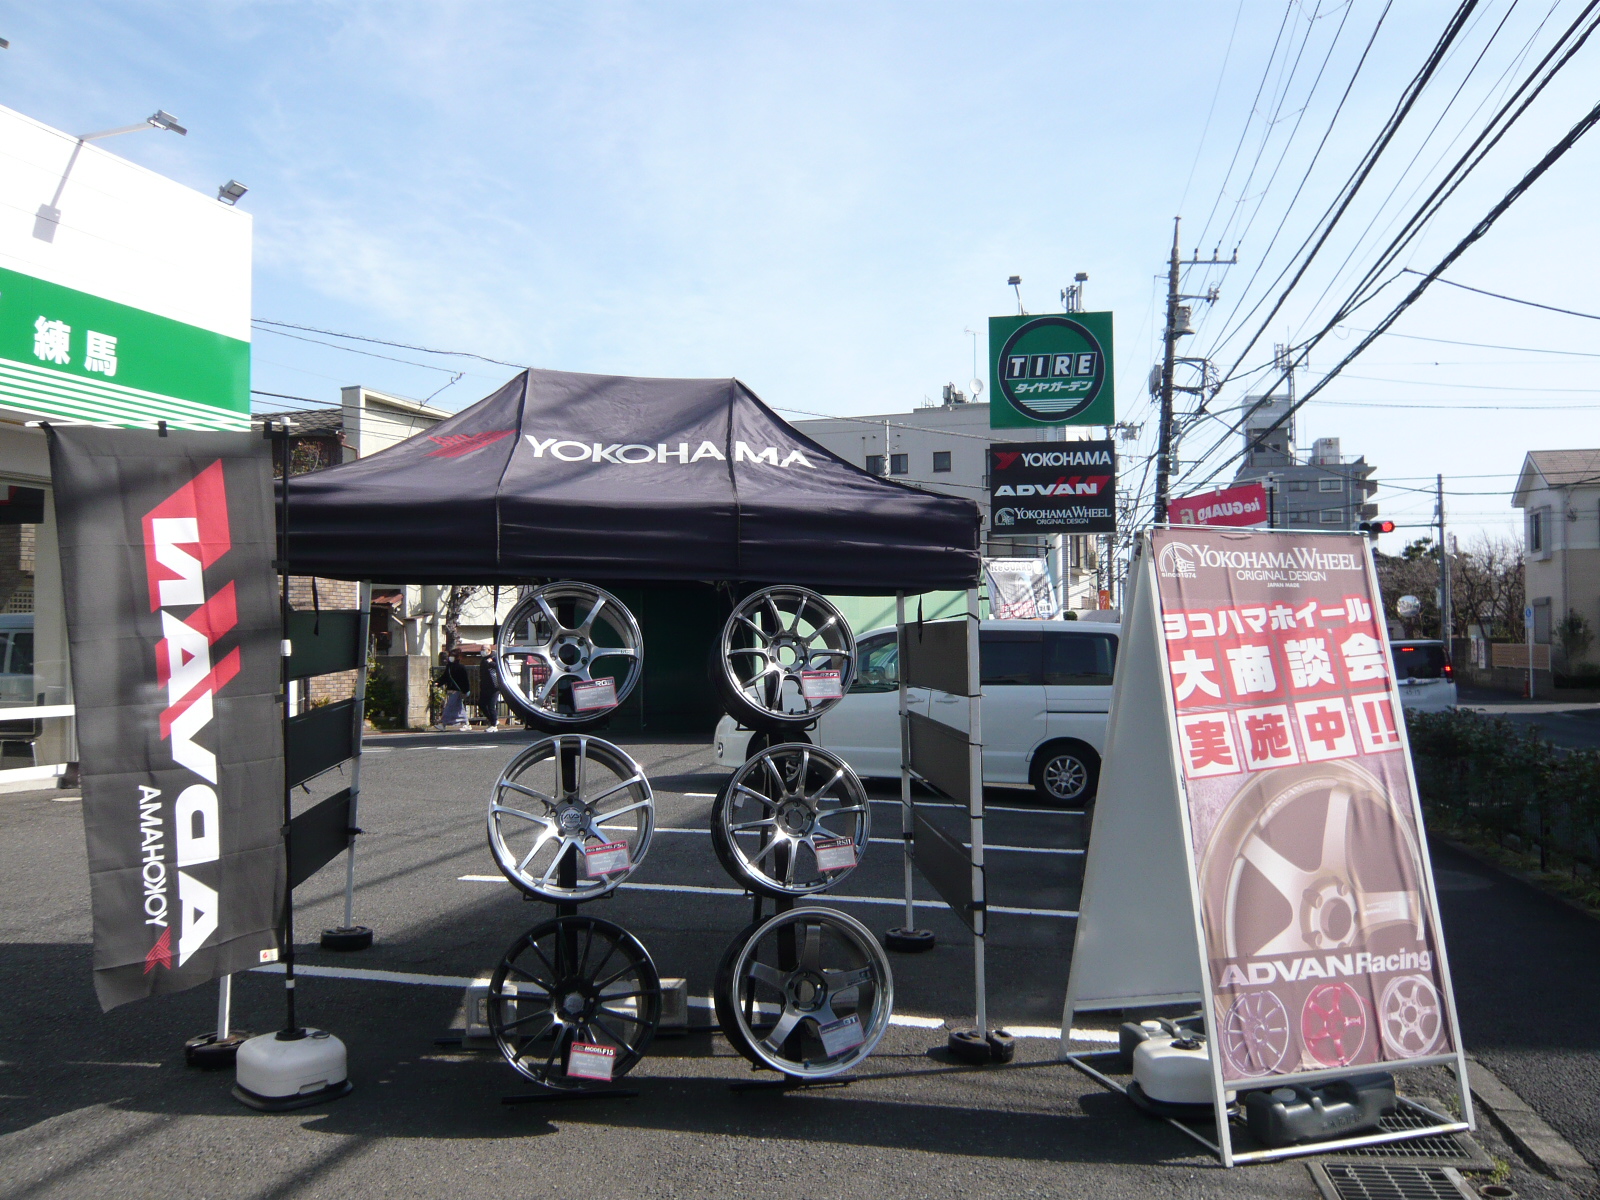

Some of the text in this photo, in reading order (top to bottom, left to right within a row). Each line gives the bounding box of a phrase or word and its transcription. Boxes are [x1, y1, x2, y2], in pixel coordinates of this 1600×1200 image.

[33, 315, 118, 377] 練馬
[1011, 354, 1092, 377] TIRE
[1014, 380, 1093, 394] タイヤガーデン
[523, 433, 818, 469] YOKOHAMA
[1021, 450, 1112, 467] YOKOHAMA
[994, 482, 1097, 497] ADVAN
[1014, 505, 1112, 520] YOKOHAMA WHEEL
[1036, 517, 1089, 526] ORIGINAL DESIGN
[1191, 544, 1362, 570] YOKOHAMA WHEEL
[1236, 569, 1327, 582] ORIGINAL DESIGN
[1163, 597, 1372, 640] ヨコハマホイール
[1170, 632, 1387, 702] 大商談会
[1218, 947, 1433, 988] ADVAN Racing
